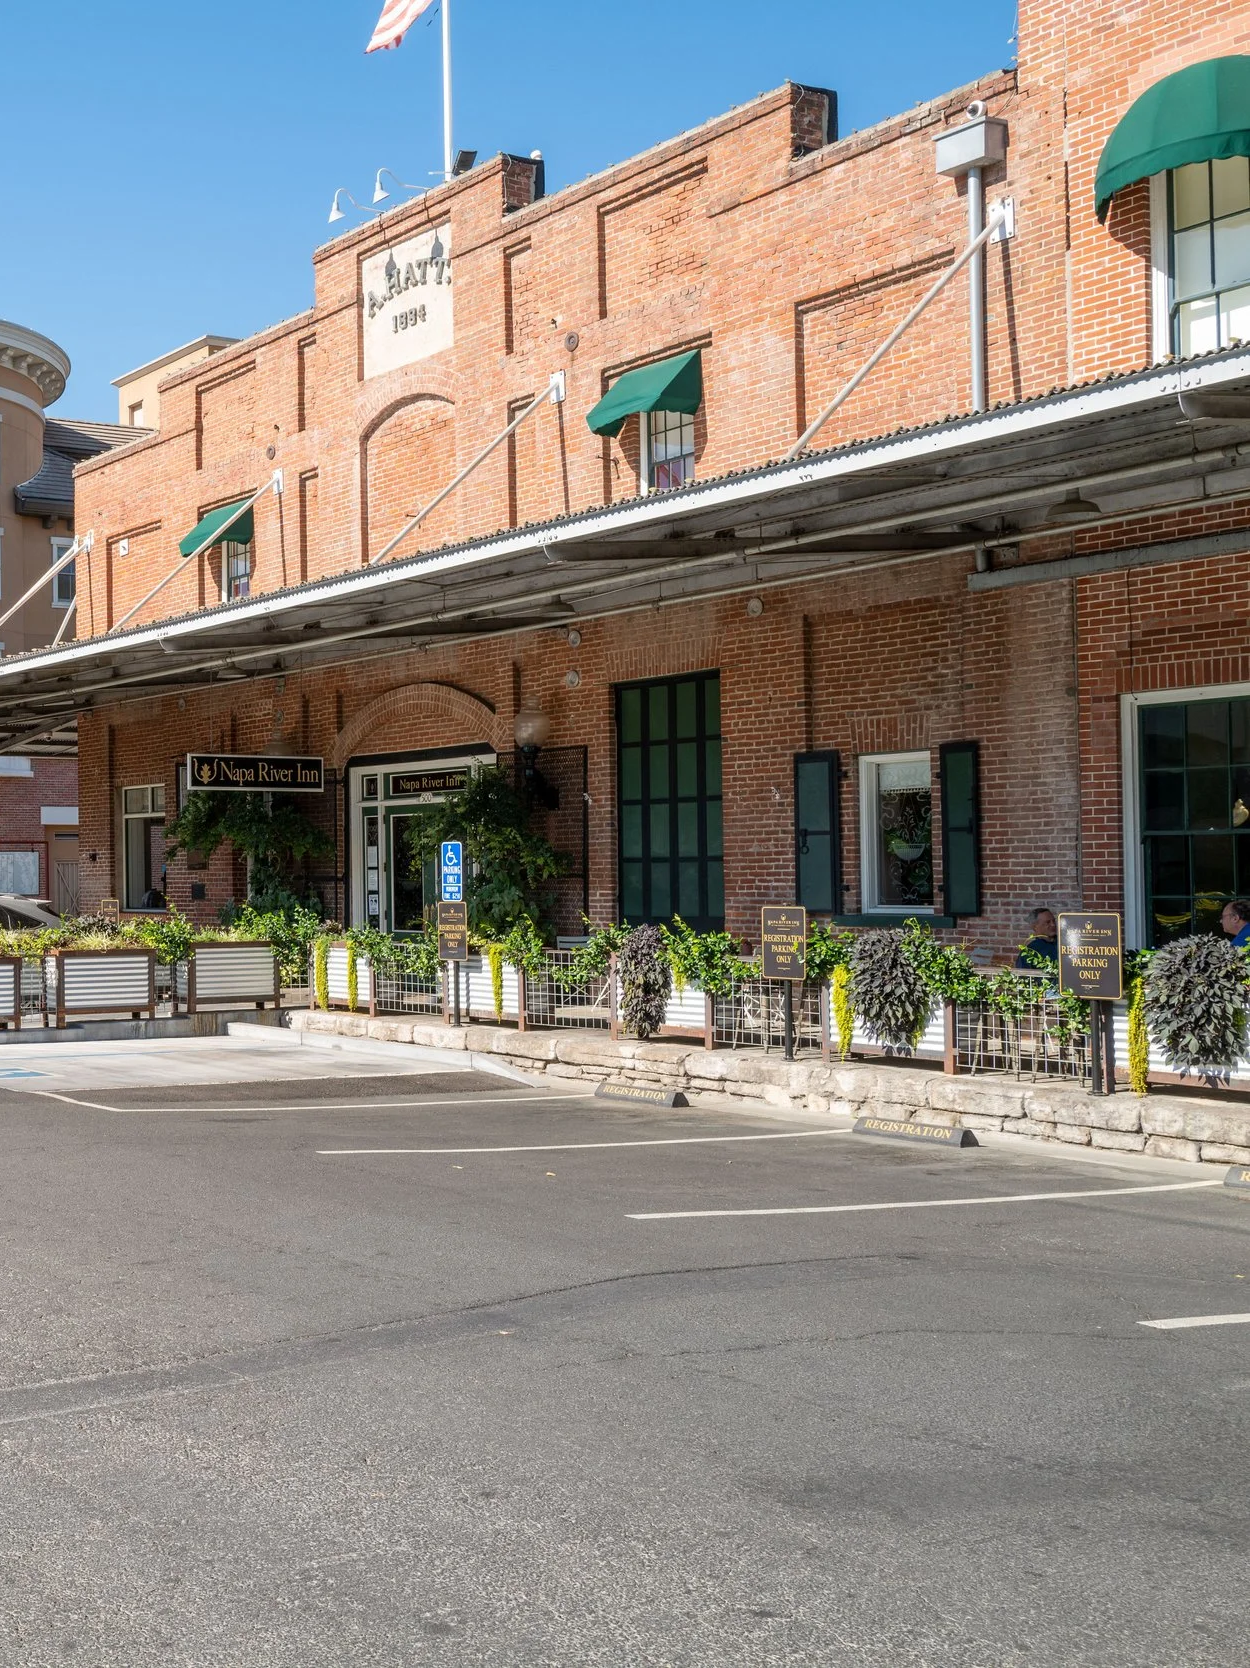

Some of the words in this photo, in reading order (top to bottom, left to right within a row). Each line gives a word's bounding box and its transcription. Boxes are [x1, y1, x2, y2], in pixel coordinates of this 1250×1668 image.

[392, 303, 427, 334] 1884
[219, 761, 255, 787] Napa
[257, 762, 294, 782] River
[296, 763, 319, 783] Inn
[399, 779, 420, 792] Napa
[421, 776, 445, 789] River
[446, 775, 461, 787] Inn
[443, 865, 461, 874] PARKING
[446, 875, 458, 883] ONLY
[444, 932, 462, 940] PARKING
[763, 934, 804, 943] REGISTRATION
[771, 944, 797, 953] PARKING
[1061, 945, 1119, 956] REGISTRATION
[776, 955, 792, 964] ONLY
[1072, 958, 1108, 967] PARKING
[1079, 970, 1101, 980] ONLY
[603, 1085, 668, 1100] REGISTRATION
[864, 1119, 953, 1139] REGISTRATION
